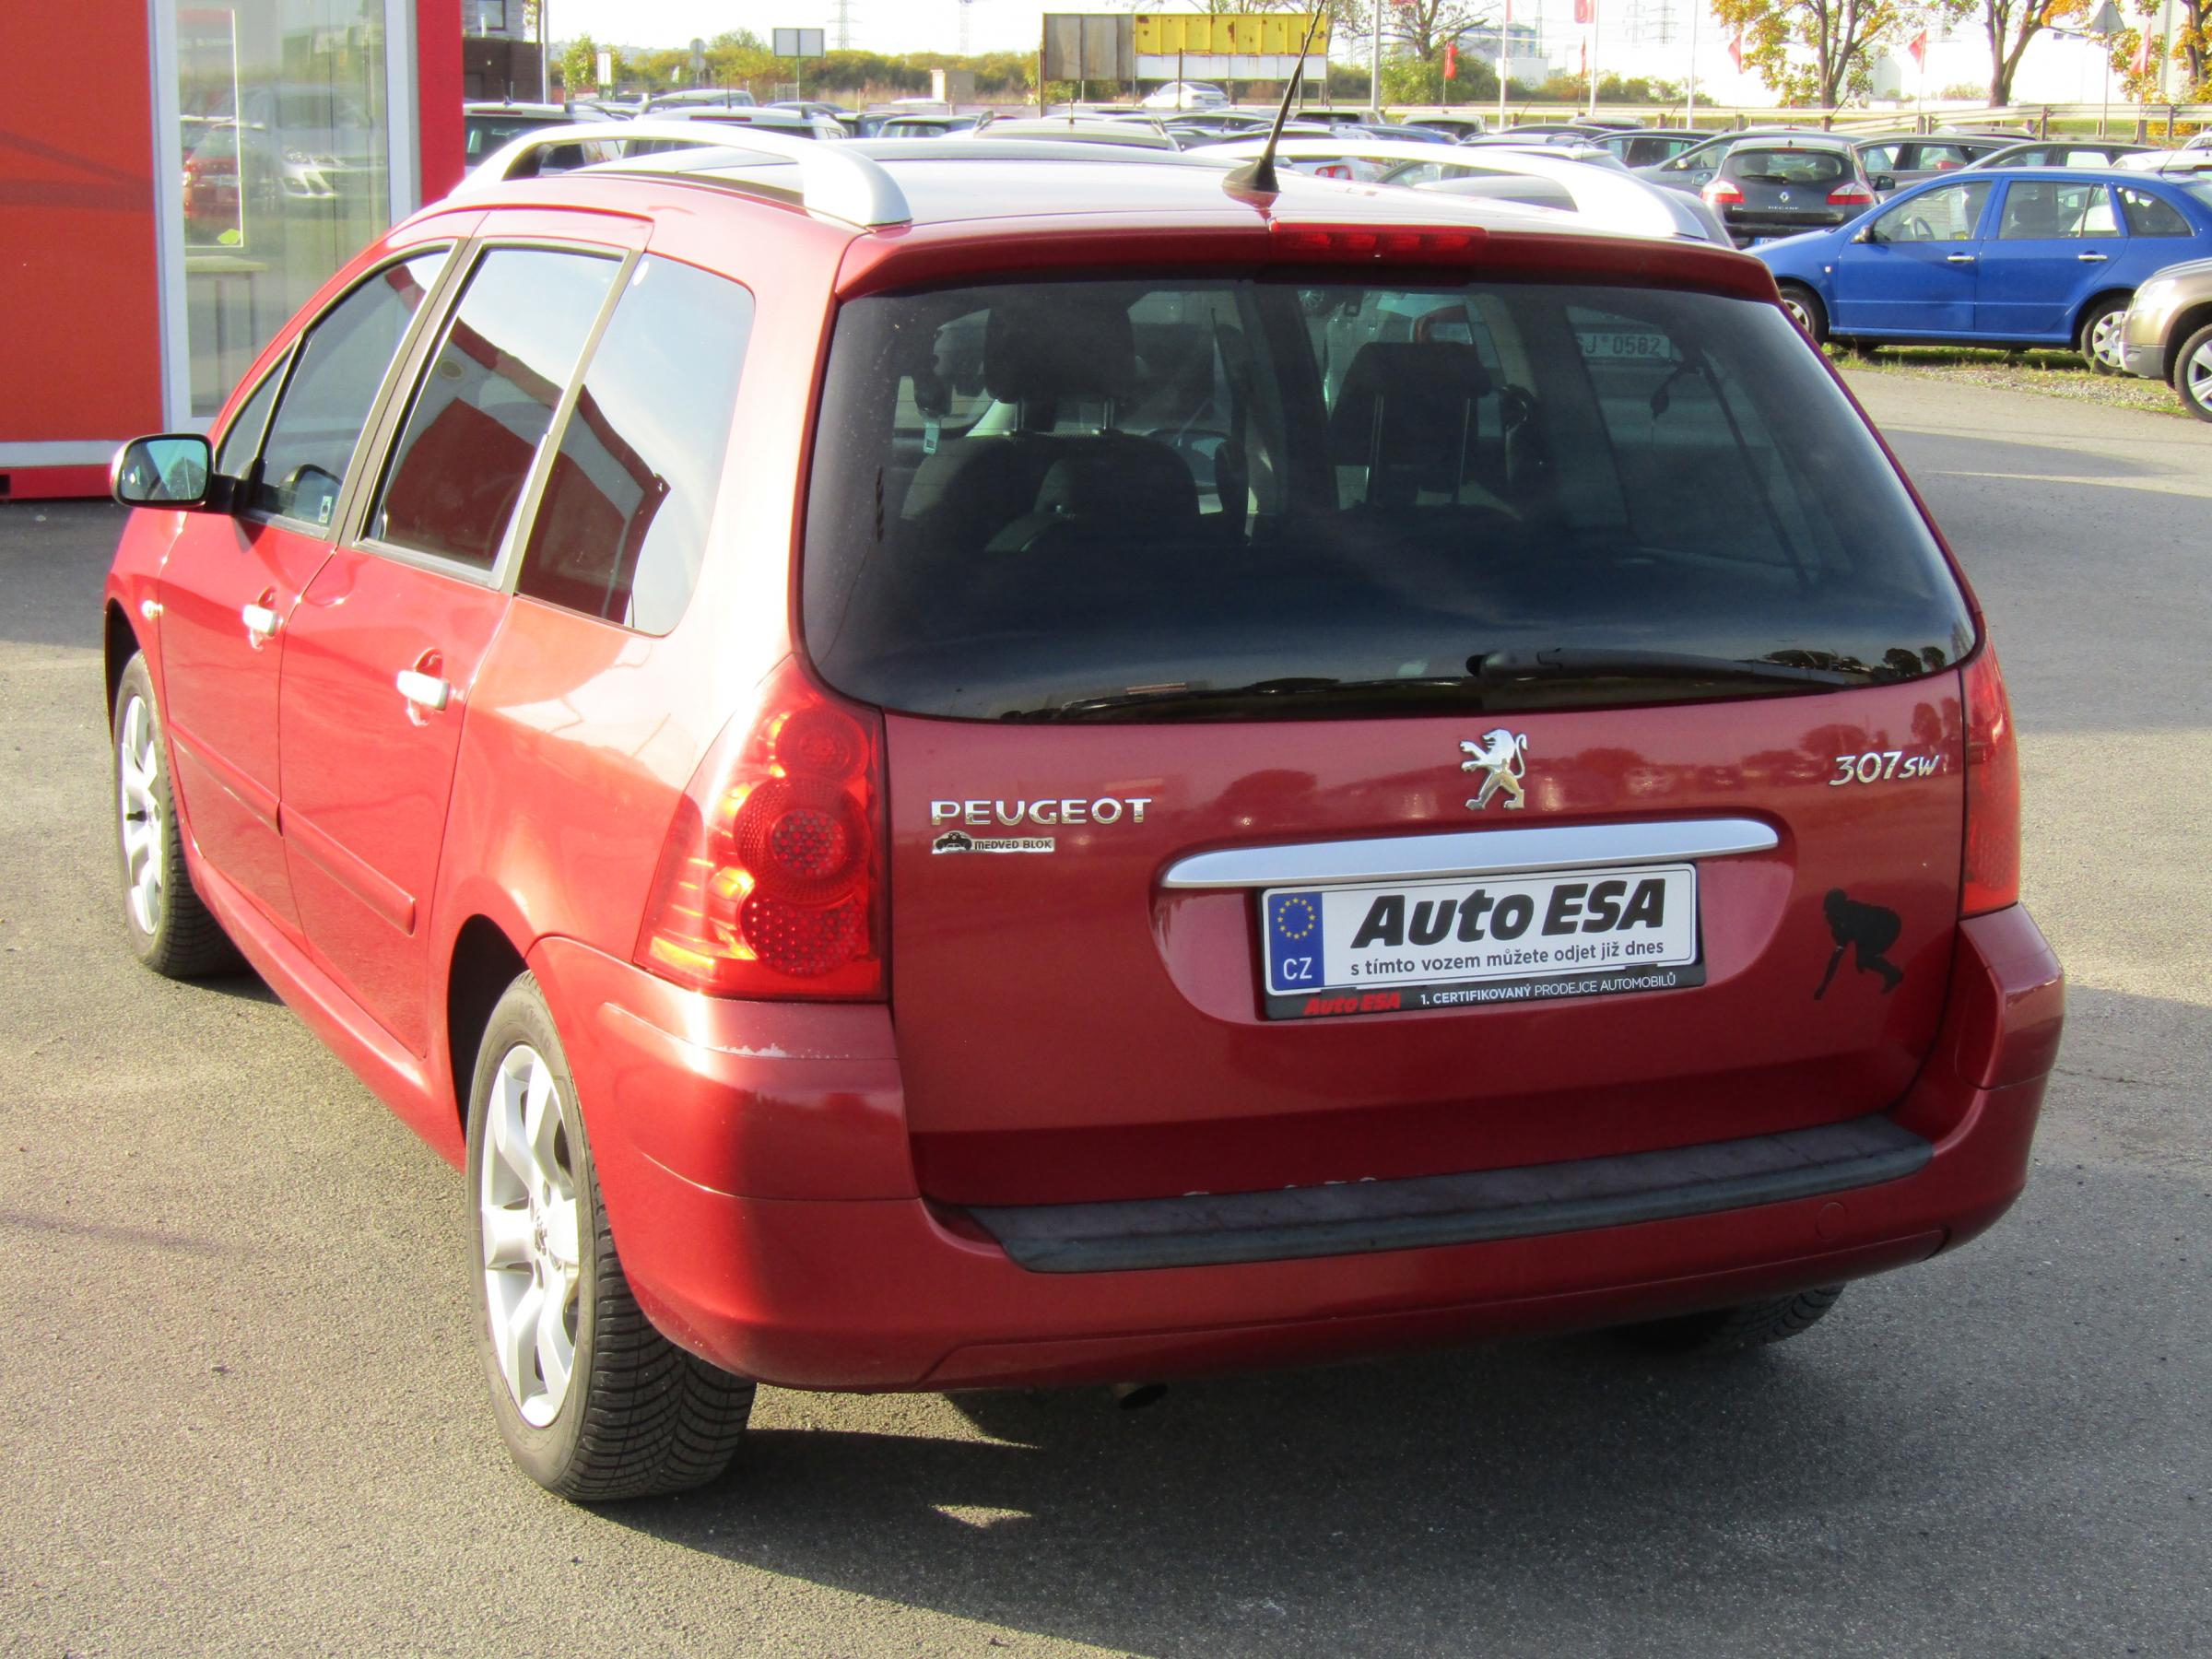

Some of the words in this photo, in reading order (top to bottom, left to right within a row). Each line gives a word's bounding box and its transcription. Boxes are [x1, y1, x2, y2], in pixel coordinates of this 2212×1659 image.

[931, 797, 1152, 826] PEUGEOT
[974, 840, 1019, 850] MEDVED
[1023, 840, 1052, 849] BLOK
[1350, 888, 1535, 949] Auto
[1541, 878, 1666, 935] ESA
[1283, 957, 1312, 981] CZ
[1351, 964, 1359, 976] s
[1366, 958, 1416, 975] tímto
[1421, 956, 1480, 971] vozem
[1487, 948, 1548, 967] můžete
[1554, 944, 1596, 962] odjet
[1601, 940, 1619, 960] již
[1625, 940, 1665, 957] dnes
[1359, 991, 1401, 1011] ESA
[1420, 994, 1430, 1006] 1.
[1432, 983, 1532, 1005] CERTIFIKOVANÝ
[1535, 981, 1597, 996] PRODEJCE
[1600, 971, 1677, 992] AUTOMOBILŮ
